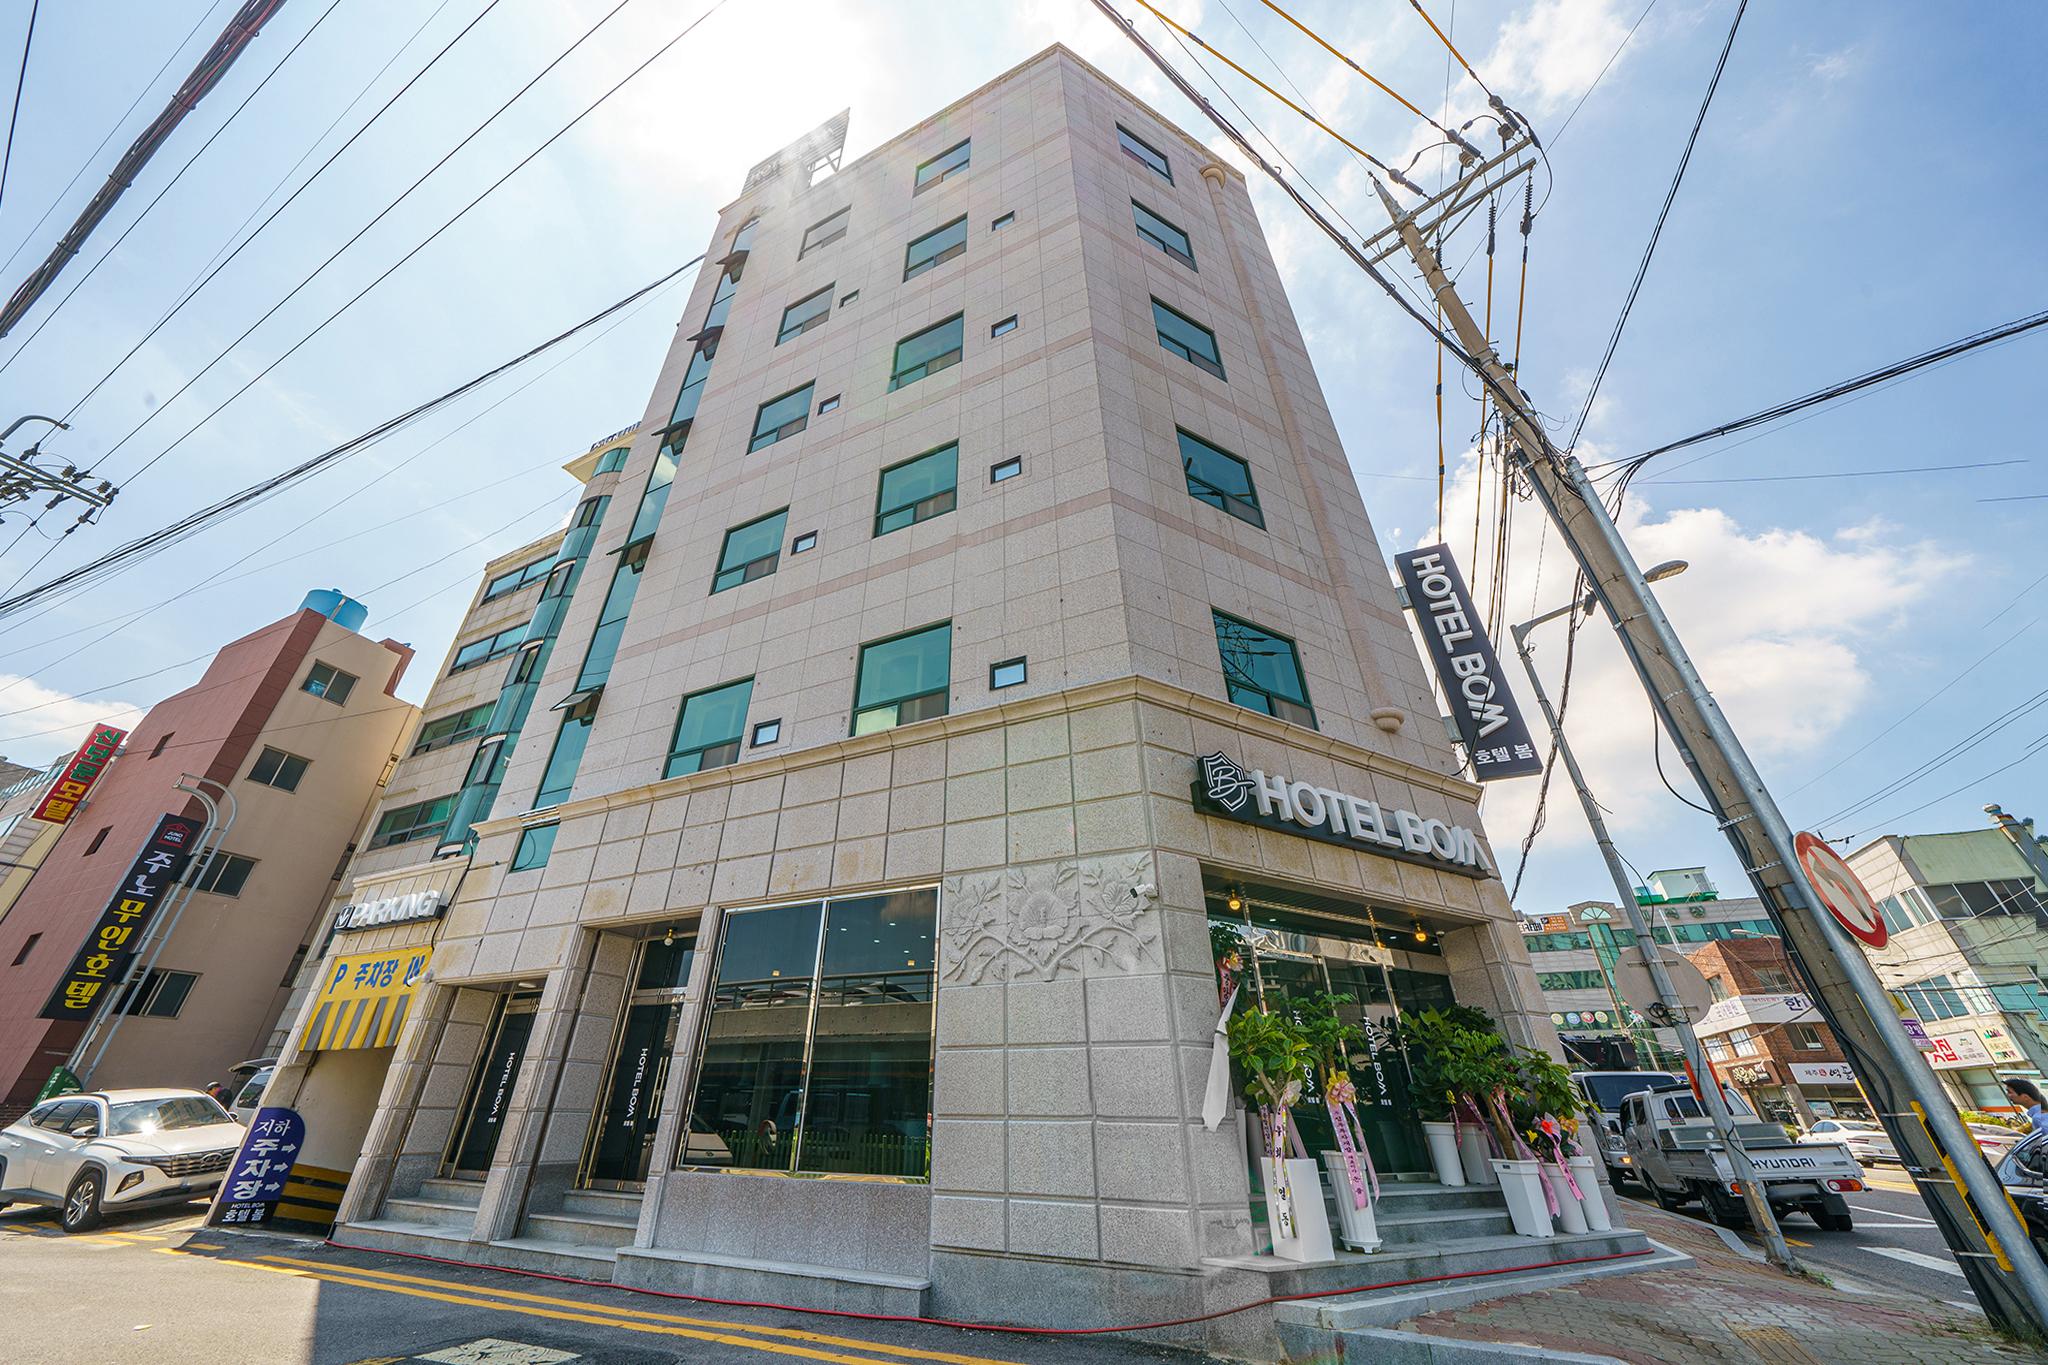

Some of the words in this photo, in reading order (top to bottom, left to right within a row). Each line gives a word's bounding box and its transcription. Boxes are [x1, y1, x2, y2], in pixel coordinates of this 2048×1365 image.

[1412, 553, 1473, 654] HOTEL
[1451, 652, 1509, 739] BOM
[1475, 746, 1511, 765] 호텔
[1514, 743, 1533, 760] 봄
[1251, 769, 1403, 849] HOTEL
[1394, 809, 1493, 870] BOM
[163, 834, 182, 842] HOTEL
[347, 890, 440, 929] PARKING
[328, 963, 348, 995] P
[353, 959, 400, 991] 주차장
[500, 1052, 516, 1089] HOTEL
[633, 1048, 648, 1087] HOTEL
[1363, 1016, 1378, 1061] HOTEL
[1374, 1062, 1388, 1096] BOM
[491, 1088, 504, 1115] BOM
[627, 1087, 640, 1117] BOM
[254, 1119, 290, 1136] 지하
[1751, 1157, 1816, 1169] HYUNDAI
[222, 1209, 251, 1222] 호텔
[251, 1208, 266, 1221] 봄
